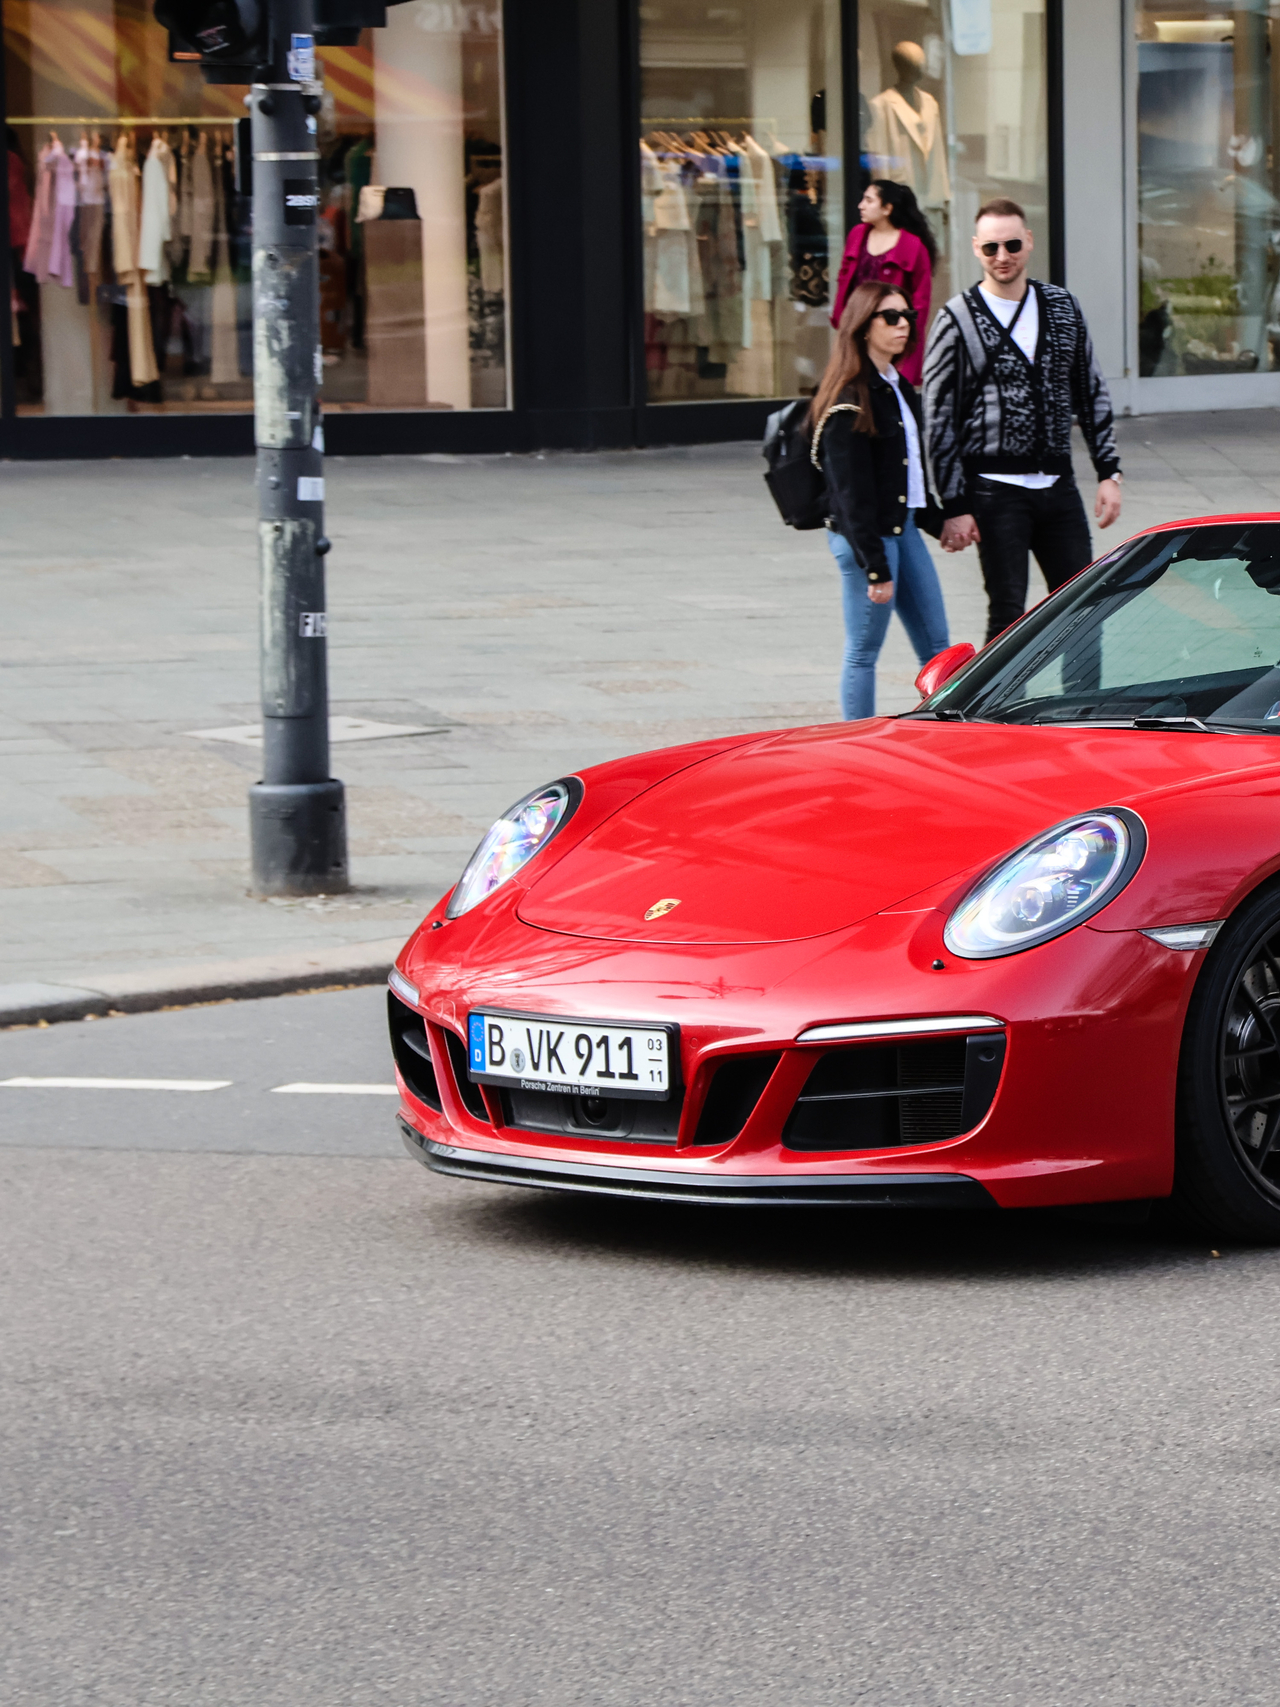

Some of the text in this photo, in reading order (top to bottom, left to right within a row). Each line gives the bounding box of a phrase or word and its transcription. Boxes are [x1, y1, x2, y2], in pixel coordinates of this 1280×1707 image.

[647, 1038, 662, 1051] 03
[474, 1049, 482, 1062] D
[488, 1023, 639, 1080] B VK 911
[649, 1070, 663, 1083] 11
[521, 1079, 599, 1096] Porsche Zentren in Berlin
